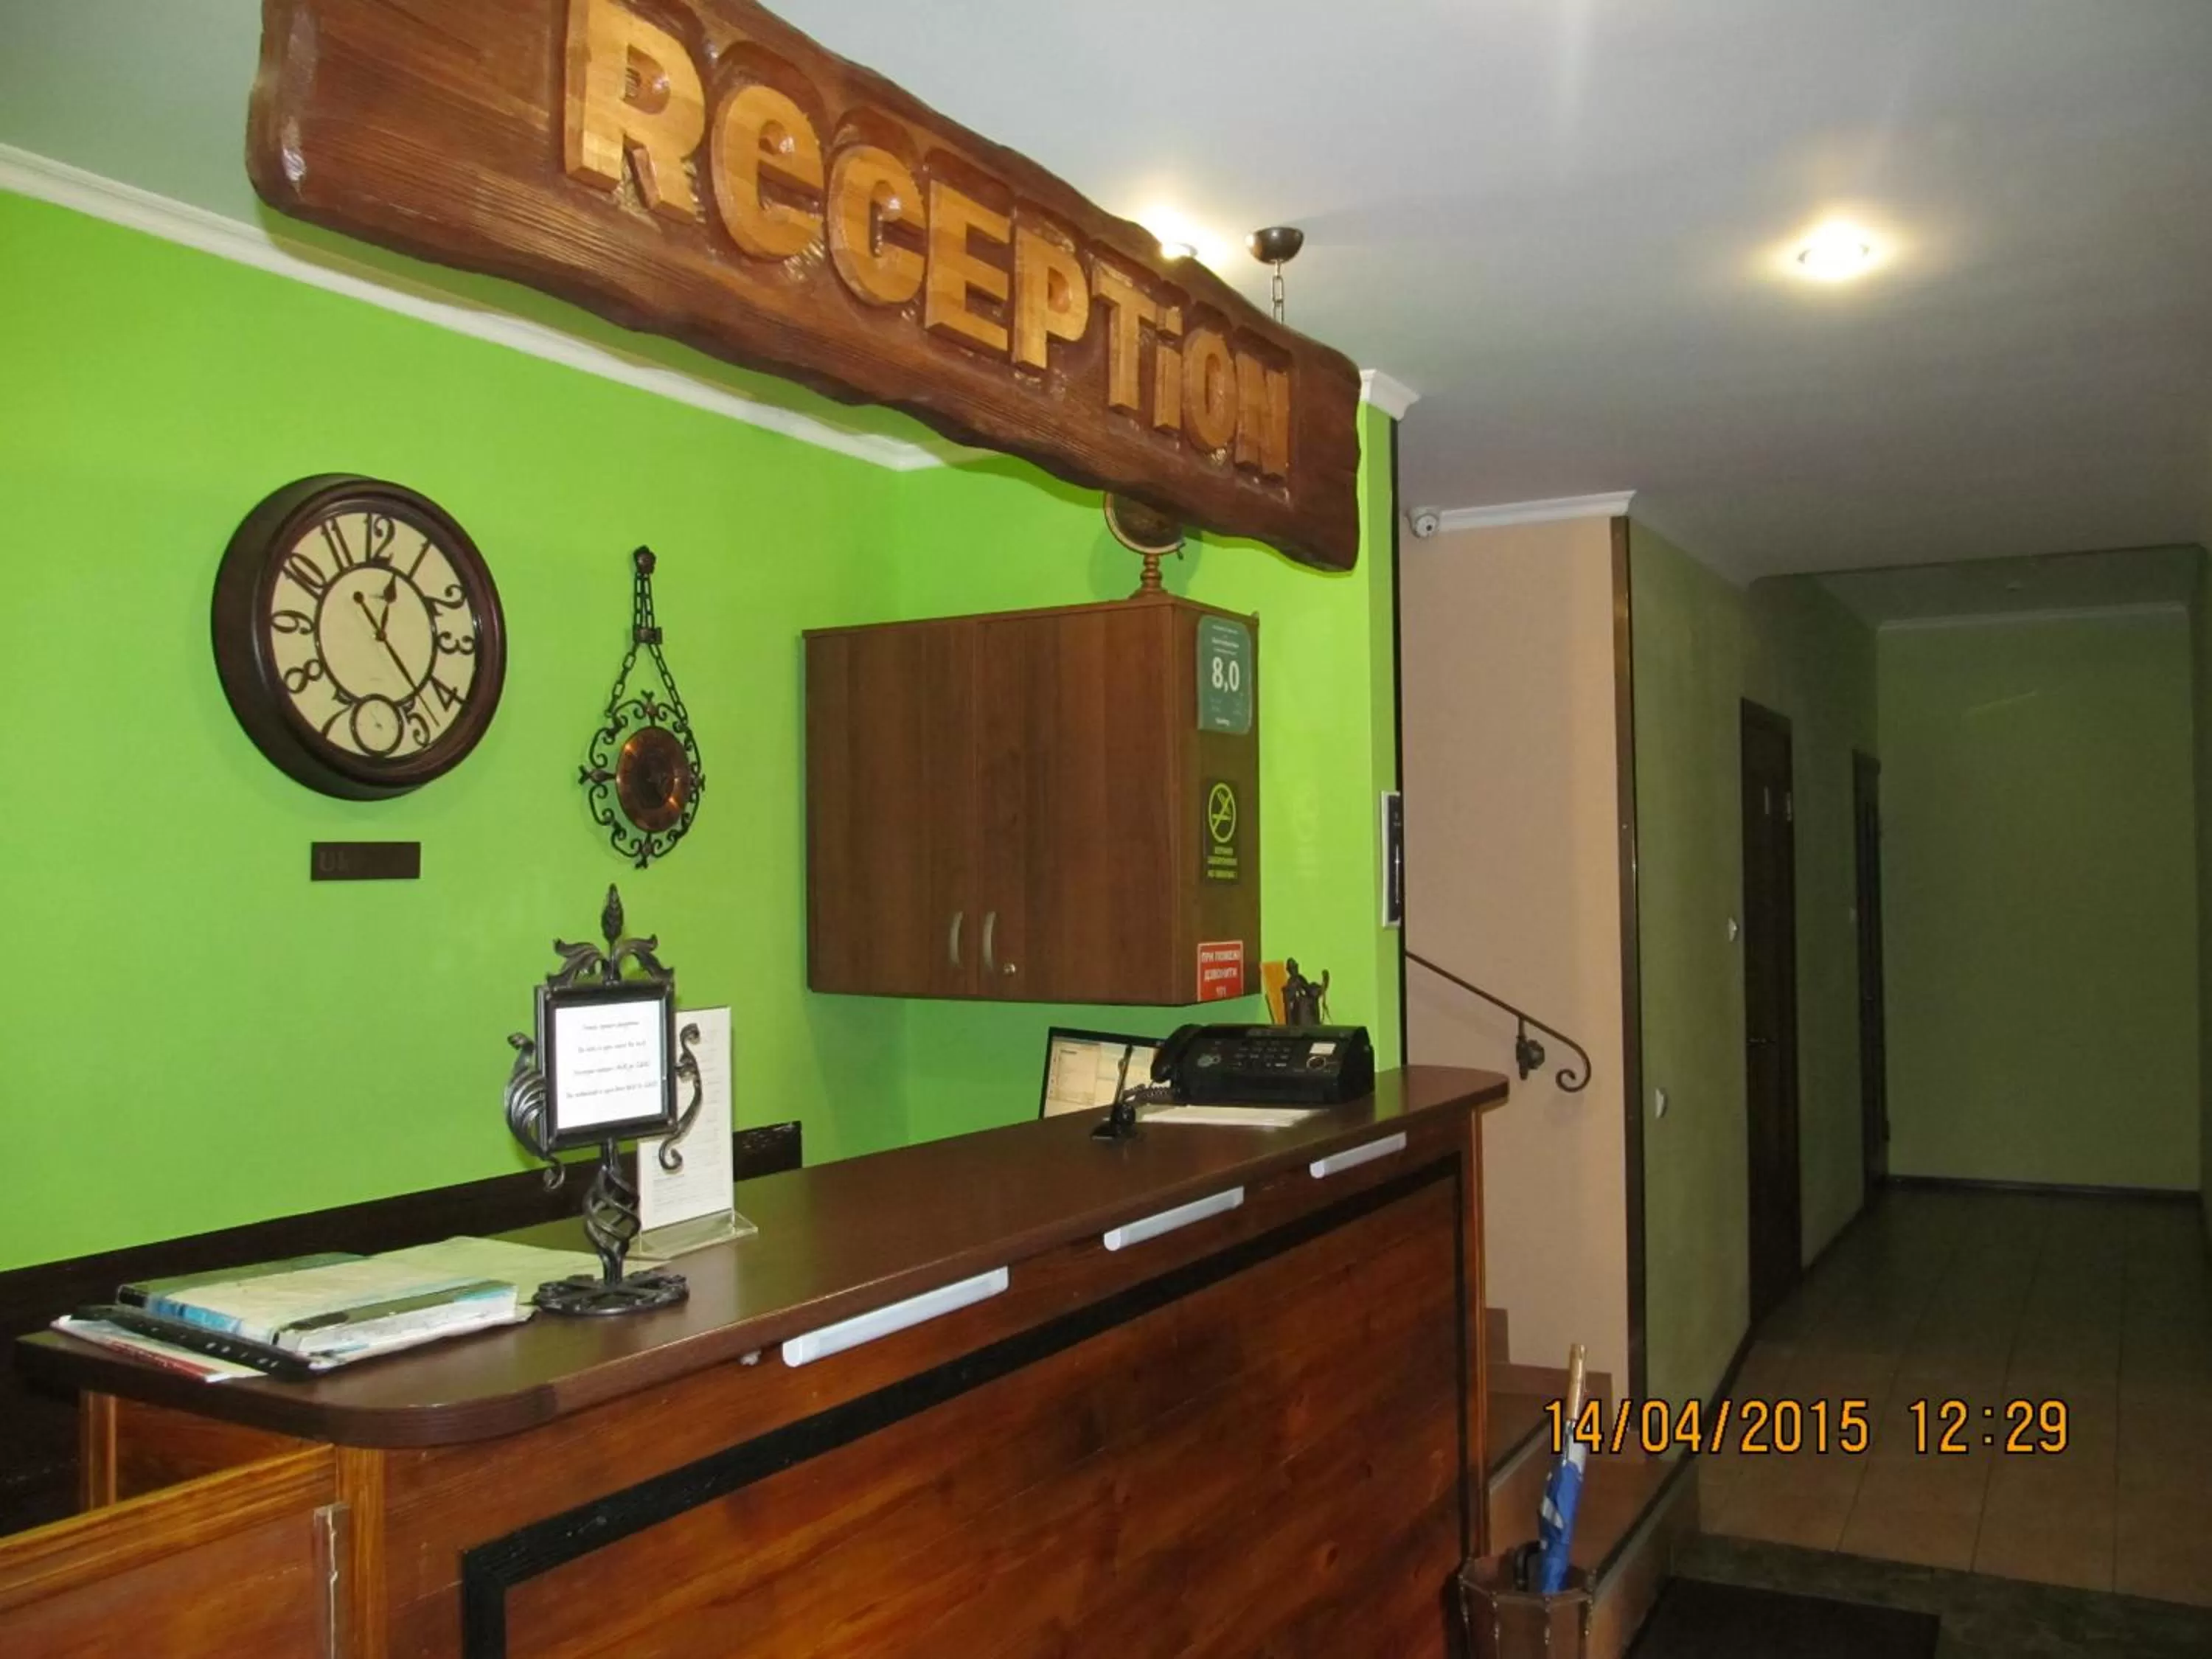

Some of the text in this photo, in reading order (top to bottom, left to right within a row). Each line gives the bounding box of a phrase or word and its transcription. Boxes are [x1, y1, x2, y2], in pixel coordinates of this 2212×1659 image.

[364, 514, 394, 566] 12
[282, 552, 329, 599] 10
[407, 538, 432, 581] 1
[425, 584, 466, 617] 2
[271, 610, 316, 635] 9
[437, 631, 476, 655] 3
[283, 658, 324, 695] 8
[430, 675, 467, 712] 4
[398, 695, 431, 748] 5
